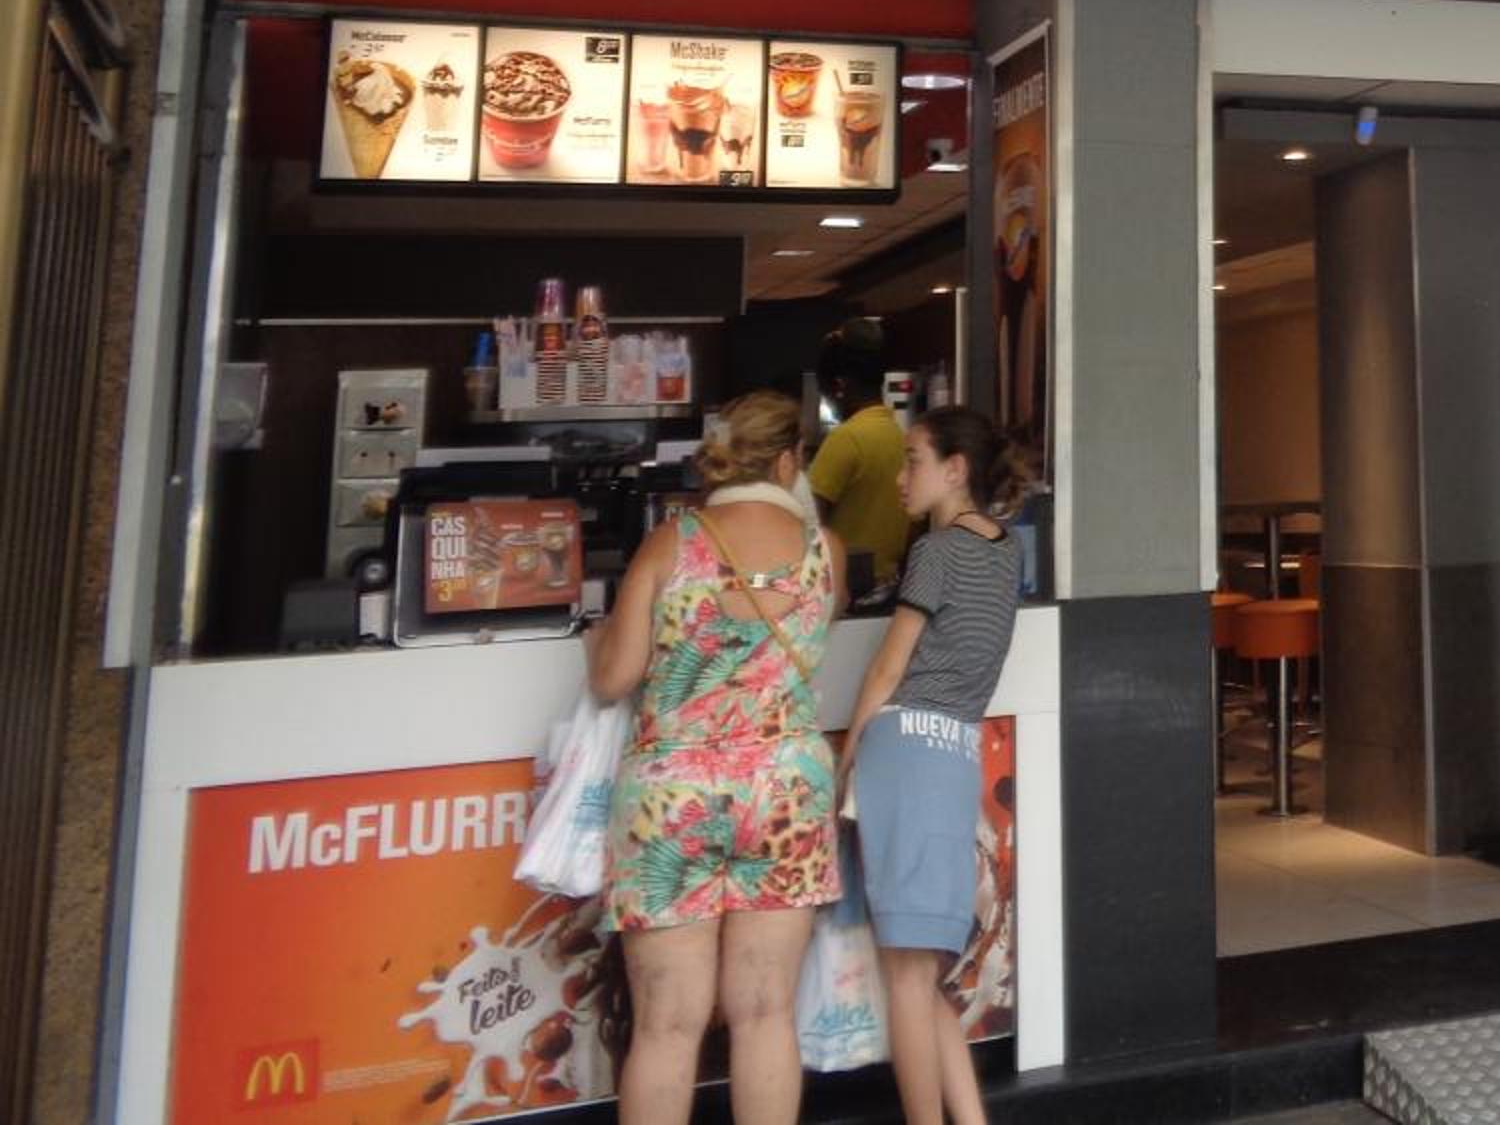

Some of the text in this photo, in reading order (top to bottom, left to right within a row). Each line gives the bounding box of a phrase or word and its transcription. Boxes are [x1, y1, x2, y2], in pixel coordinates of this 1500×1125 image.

[431, 517, 465, 536] CAS
[432, 536, 466, 560] QUI
[431, 561, 465, 580] NHA
[901, 712, 961, 743] NUEVA
[247, 791, 538, 874] McFLURR
[469, 984, 537, 1036] leite
